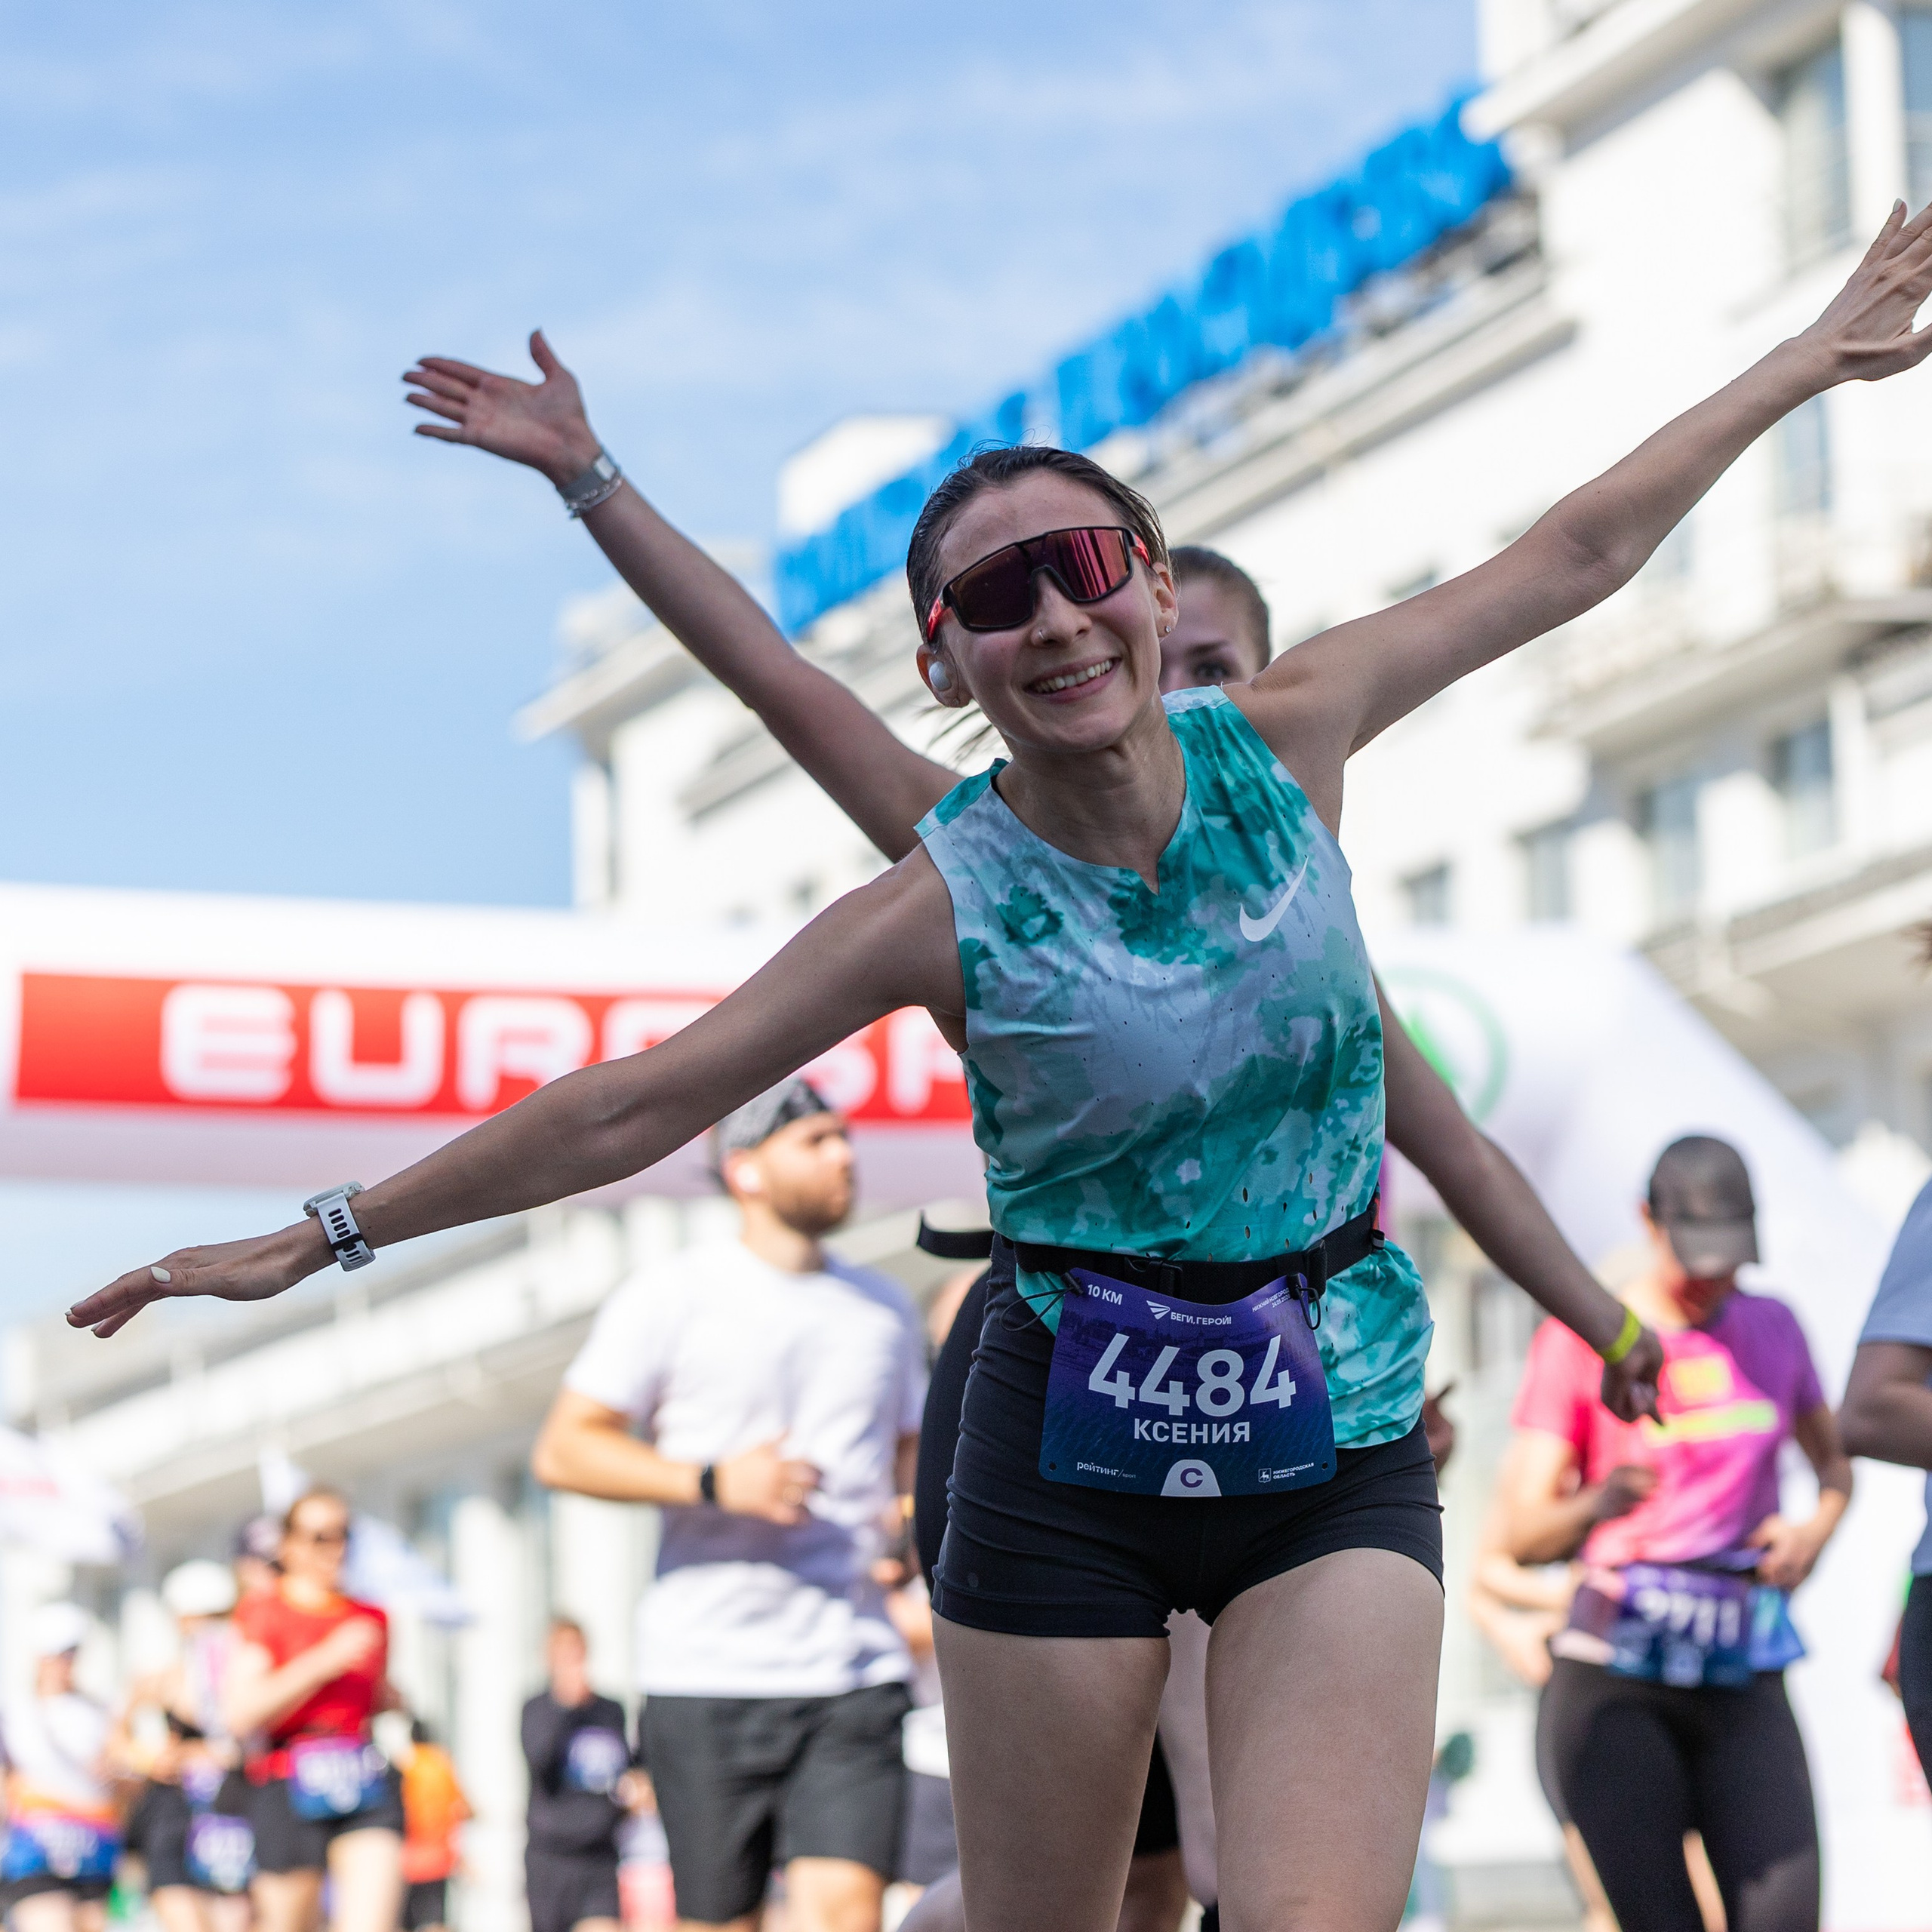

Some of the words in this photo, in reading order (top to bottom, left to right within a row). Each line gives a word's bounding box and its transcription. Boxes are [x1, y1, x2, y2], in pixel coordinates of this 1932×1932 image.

[1087, 1284, 1100, 1297] 10
[1088, 1331, 1297, 1417] 4484
[1133, 1417, 1251, 1444] КСЕНИЯ
[1272, 1462, 1315, 1475] НИЖЕГОРОДСКАЯ
